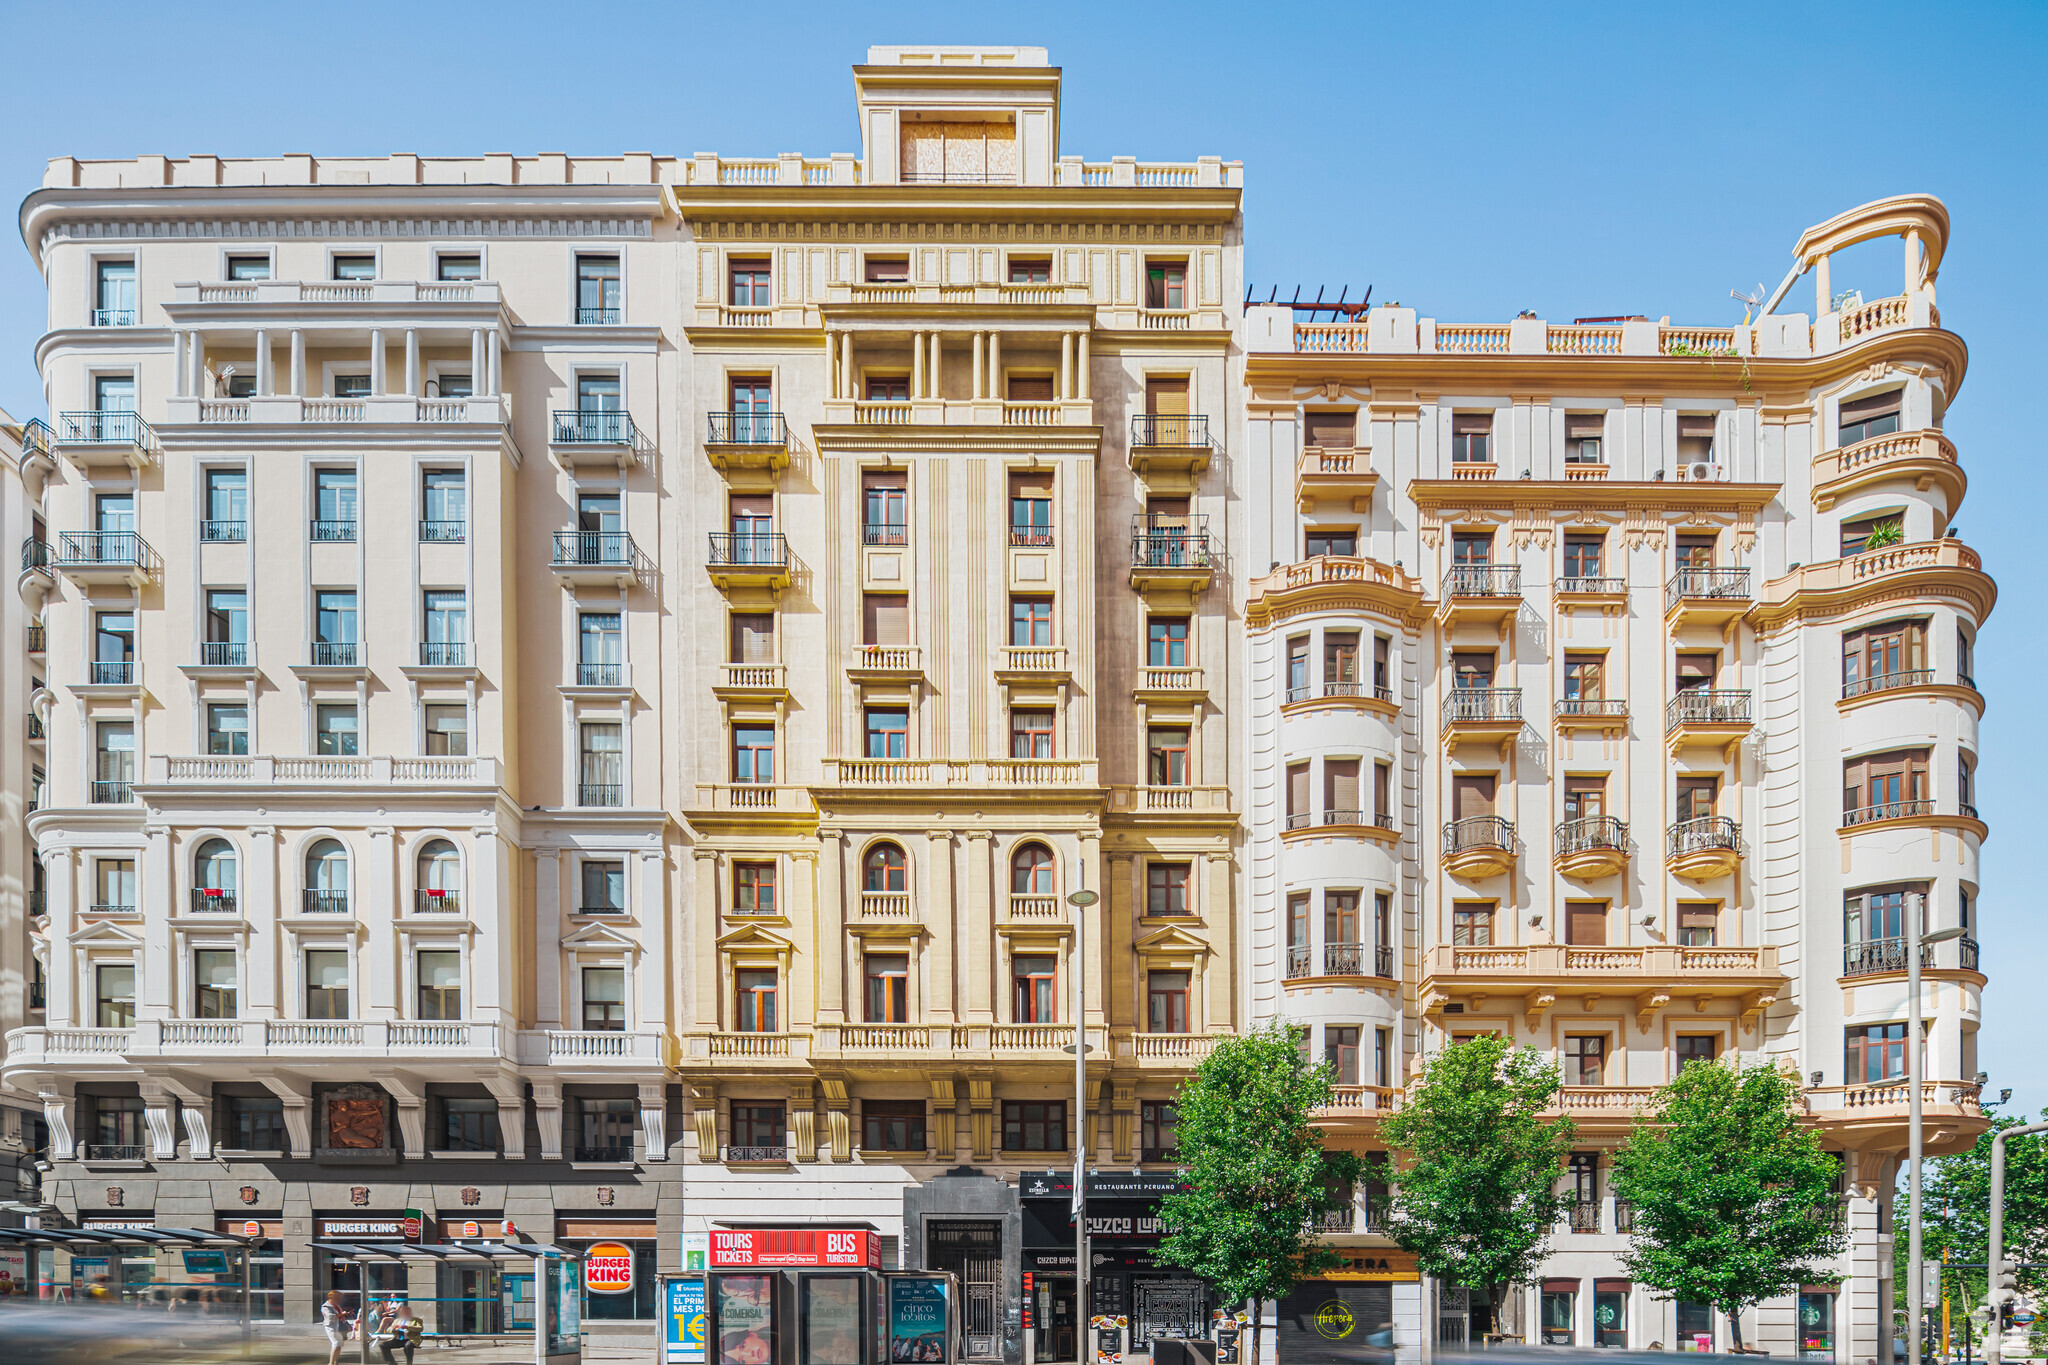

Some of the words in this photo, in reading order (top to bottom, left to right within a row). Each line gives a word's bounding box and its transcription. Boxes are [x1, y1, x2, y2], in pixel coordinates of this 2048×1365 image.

[324, 1223, 368, 1232] BURGER
[370, 1223, 398, 1232] KING
[1084, 1218, 1131, 1233] CUZCO
[715, 1233, 753, 1248] TOURS
[827, 1233, 856, 1253] BUS
[588, 1258, 630, 1267] BURGER
[715, 1251, 753, 1263] TICKETS
[826, 1253, 858, 1264] TURÍSTICO
[1336, 1258, 1389, 1269] PERA
[588, 1268, 630, 1281] KING
[904, 1304, 933, 1313] cinco
[1151, 1299, 1188, 1312] CUZCO
[726, 1309, 763, 1318] COMENSAL
[901, 1312, 936, 1321] lobitos
[1151, 1313, 1188, 1327] LUPITA
[674, 1314, 704, 1341] 1€
